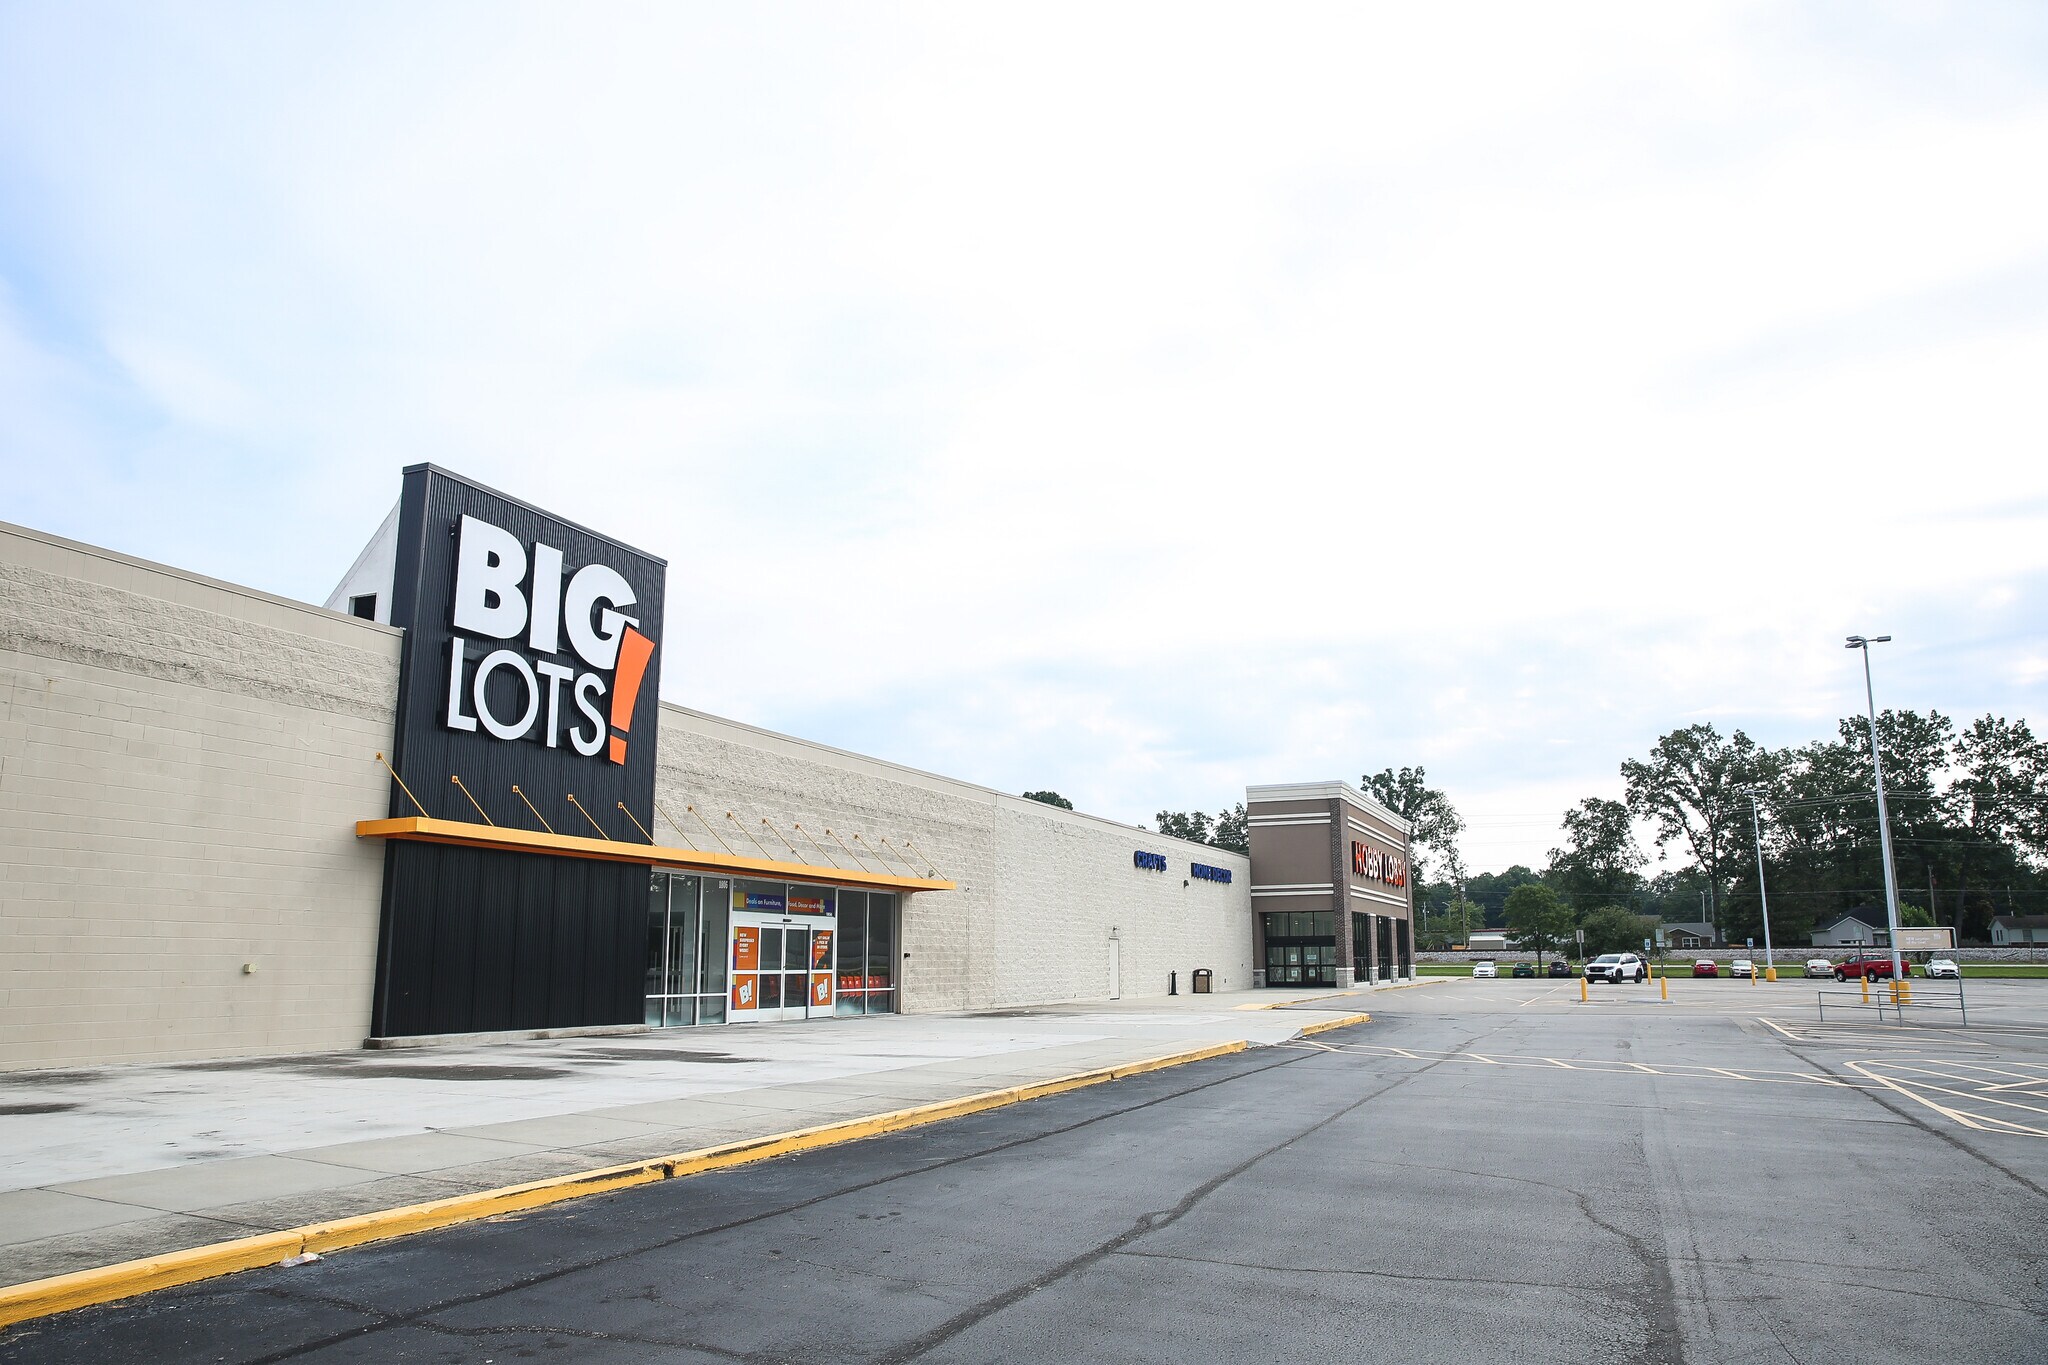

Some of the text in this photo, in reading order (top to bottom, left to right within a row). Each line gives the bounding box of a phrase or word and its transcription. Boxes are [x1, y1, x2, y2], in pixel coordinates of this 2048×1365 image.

[454, 514, 639, 670] BIG
[447, 626, 655, 765] LOTS!
[1134, 850, 1167, 872] CRAFTS
[1354, 841, 1406, 887] HOBBY LOBBY
